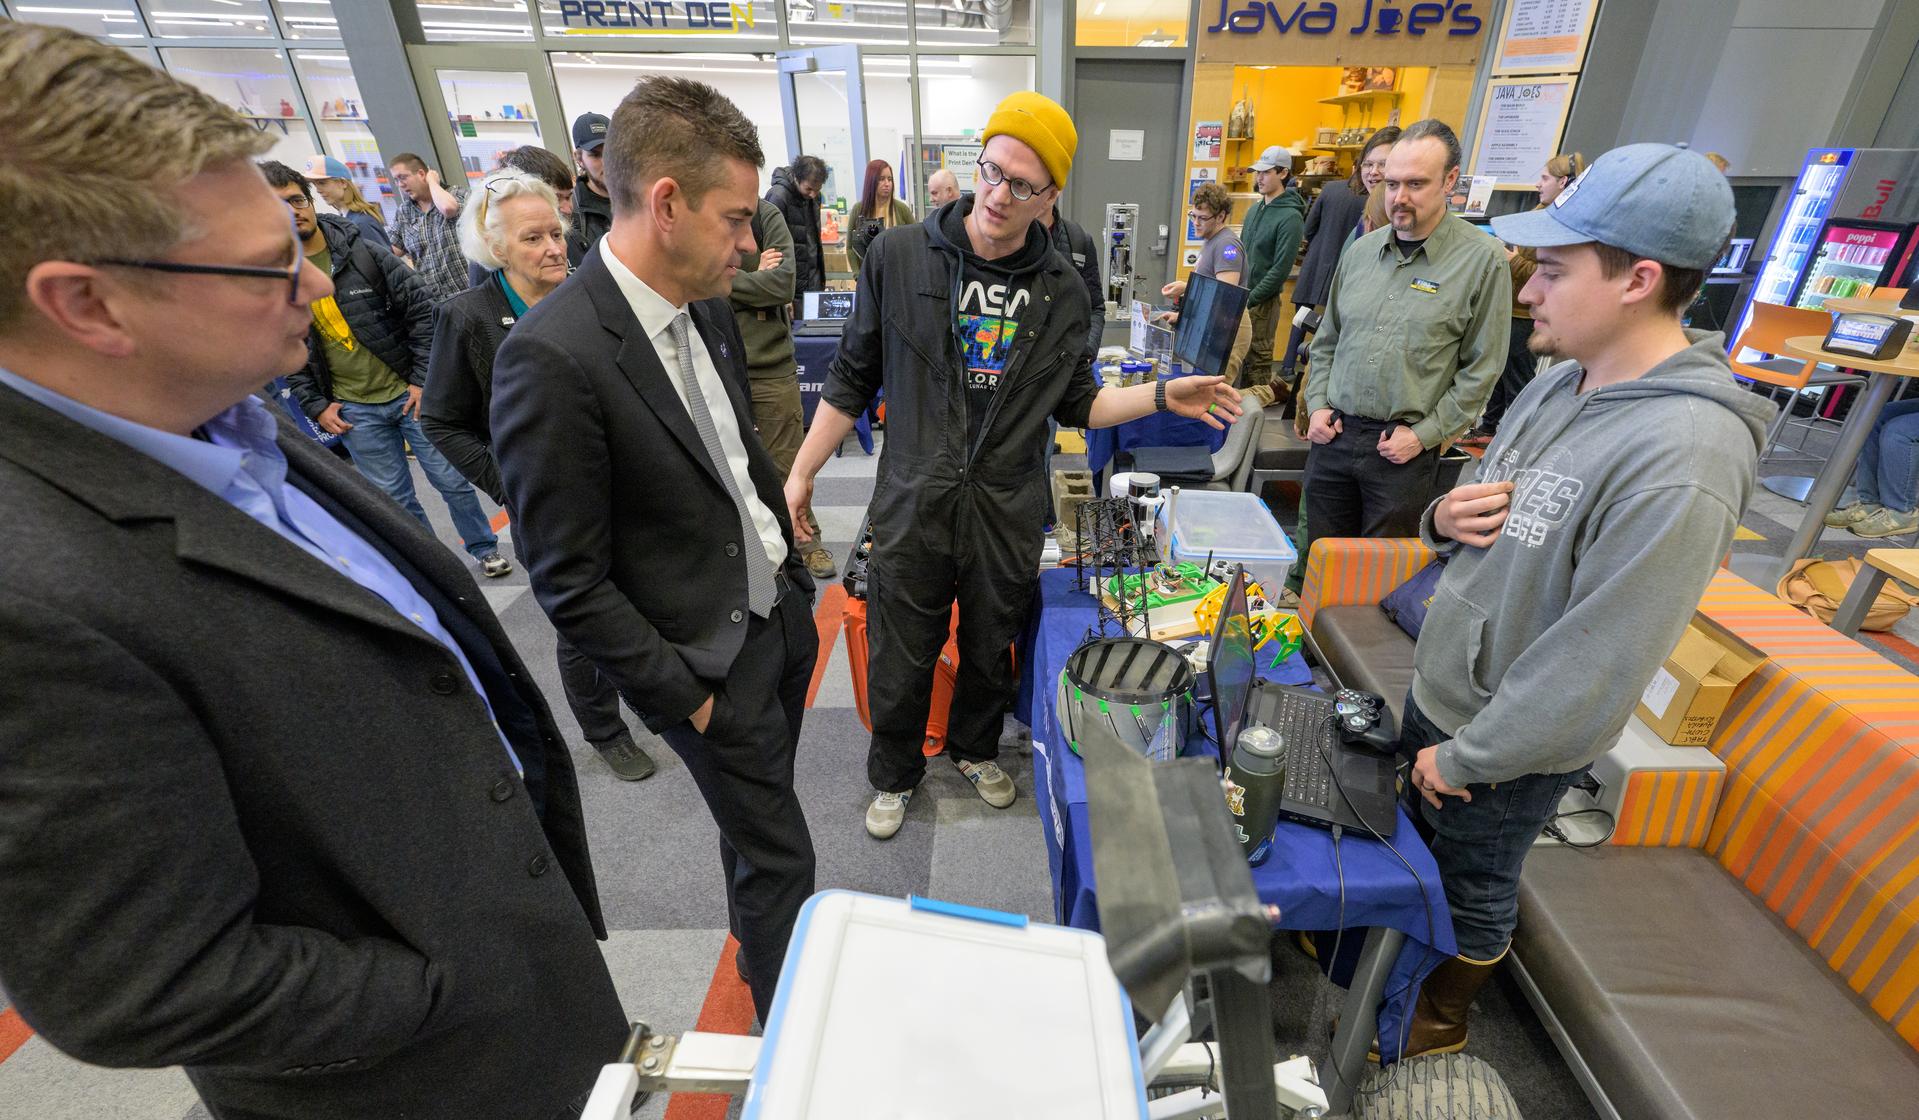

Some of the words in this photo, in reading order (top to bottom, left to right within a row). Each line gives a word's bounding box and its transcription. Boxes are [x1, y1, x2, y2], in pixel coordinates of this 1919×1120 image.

[560, 0, 673, 27] PRINT
[685, 1, 755, 31] DEN
[1208, 0, 1338, 34] Java
[1496, 86, 1515, 100] JAVA
[1846, 232, 1877, 244] poppi
[958, 280, 1031, 318] ASA
